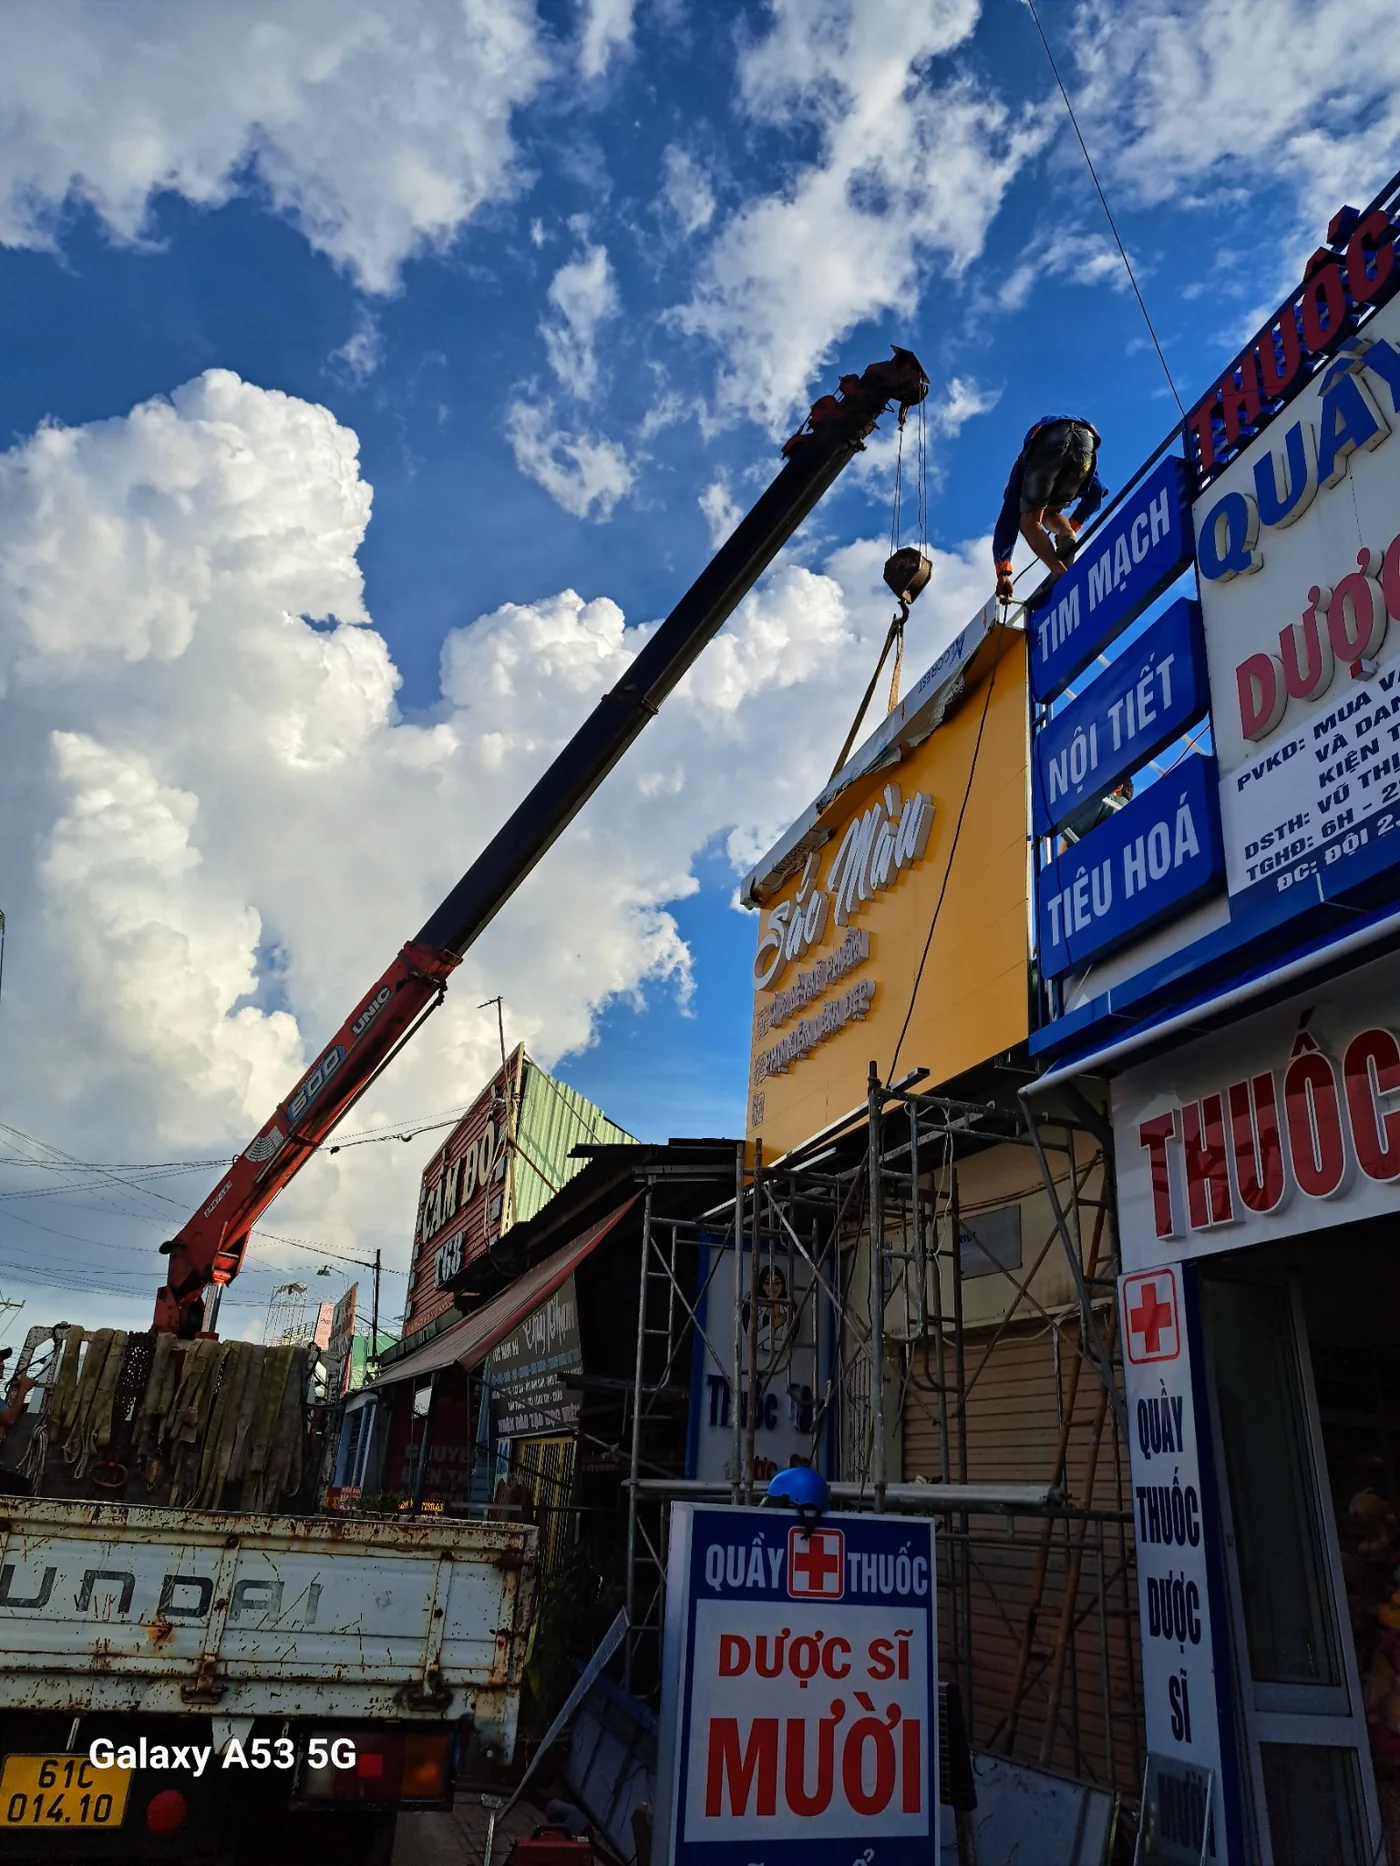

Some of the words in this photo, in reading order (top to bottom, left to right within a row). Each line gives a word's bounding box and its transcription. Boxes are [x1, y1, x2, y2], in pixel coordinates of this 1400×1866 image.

[1190, 205, 1395, 472] THUỐC
[1038, 593, 1080, 662] TIM
[1088, 487, 1170, 612] MẠCH
[1048, 722, 1098, 804] NỘI
[1108, 652, 1175, 751] TIẾT
[1237, 738, 1305, 792] PVKD:
[1313, 691, 1372, 740] MUA
[1315, 733, 1348, 763] VÀ
[1319, 738, 1380, 788] KIỆN
[1245, 813, 1310, 860] DSTH:
[1317, 782, 1350, 814] VŨ
[1247, 835, 1314, 881] TGHĐ:
[1321, 807, 1354, 838] 6H
[1276, 860, 1317, 892] ĐC:
[1324, 828, 1369, 866] ĐỘI
[1047, 858, 1113, 947] TIÊU
[1124, 791, 1200, 899] HOÁ
[352, 987, 391, 1036] UNIC
[1139, 1006, 1400, 1240] THUỐC
[1137, 1379, 1183, 1460] QUẦY
[1136, 1467, 1200, 1548] THUỐC
[705, 1532, 784, 1591] QUẦY
[847, 1541, 928, 1596] THUỐC
[1147, 1571, 1201, 1654] DƯỢC
[718, 1627, 851, 1689] DƯỢC
[867, 1629, 914, 1681] SĨ
[1168, 1669, 1192, 1743] SĨ
[38, 1759, 94, 1788] 61C
[705, 1692, 921, 1817] MƯỜI
[7, 1792, 113, 1822] 014.10
